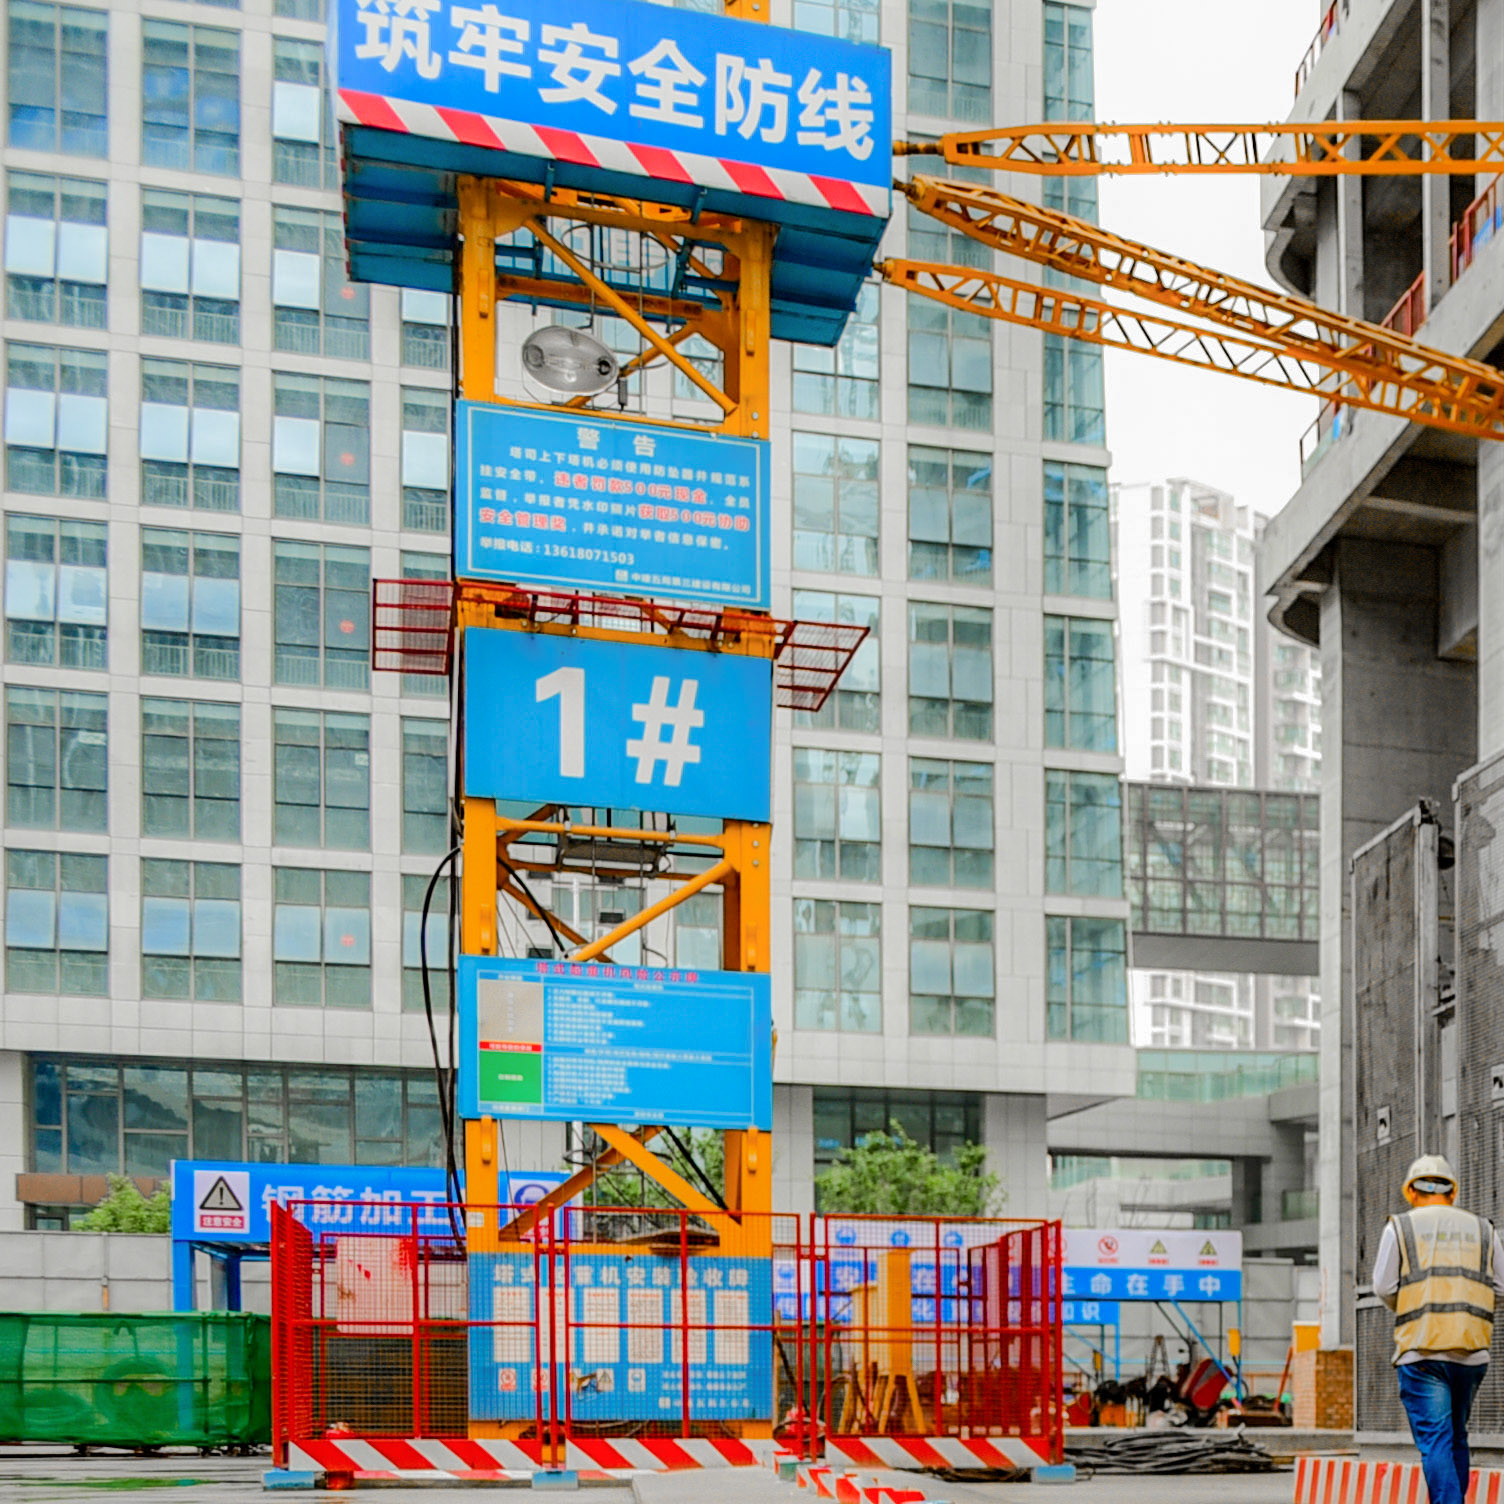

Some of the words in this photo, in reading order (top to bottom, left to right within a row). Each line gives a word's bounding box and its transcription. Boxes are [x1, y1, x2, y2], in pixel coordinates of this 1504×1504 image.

[355, 0, 875, 160] 筑牢安全防线
[535, 666, 704, 787] 1#
